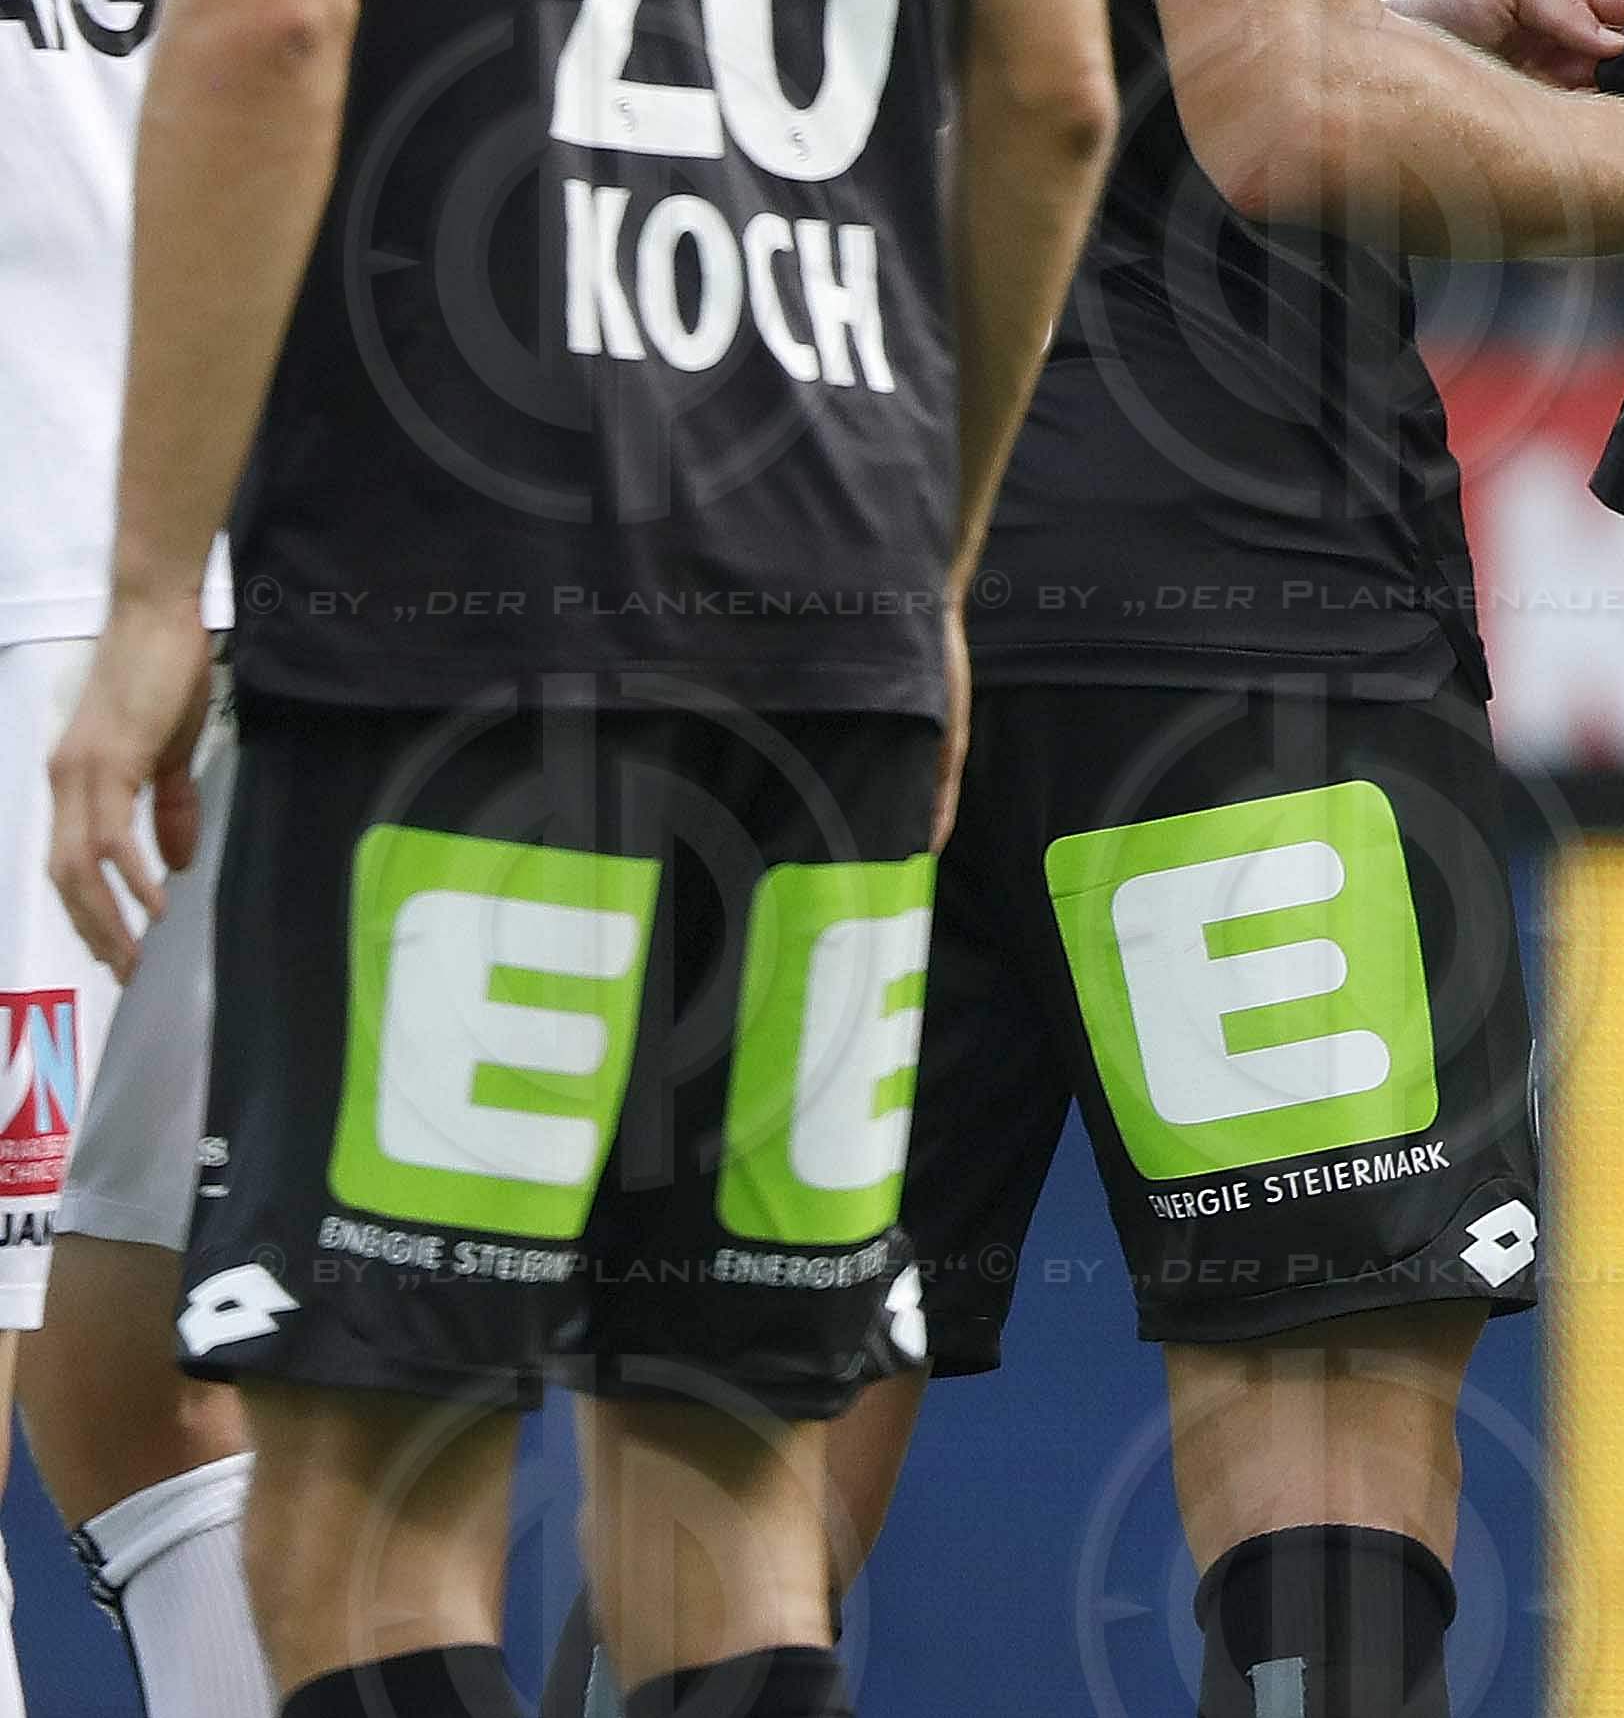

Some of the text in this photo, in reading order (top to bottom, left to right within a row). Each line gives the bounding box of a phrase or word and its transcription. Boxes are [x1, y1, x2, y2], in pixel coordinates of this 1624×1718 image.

[562, 178, 897, 394] KOCH
[375, 888, 642, 1187] E
[1112, 839, 1391, 1125] E
[1148, 1140, 1450, 1220] ENERGIE STEIERMARK
